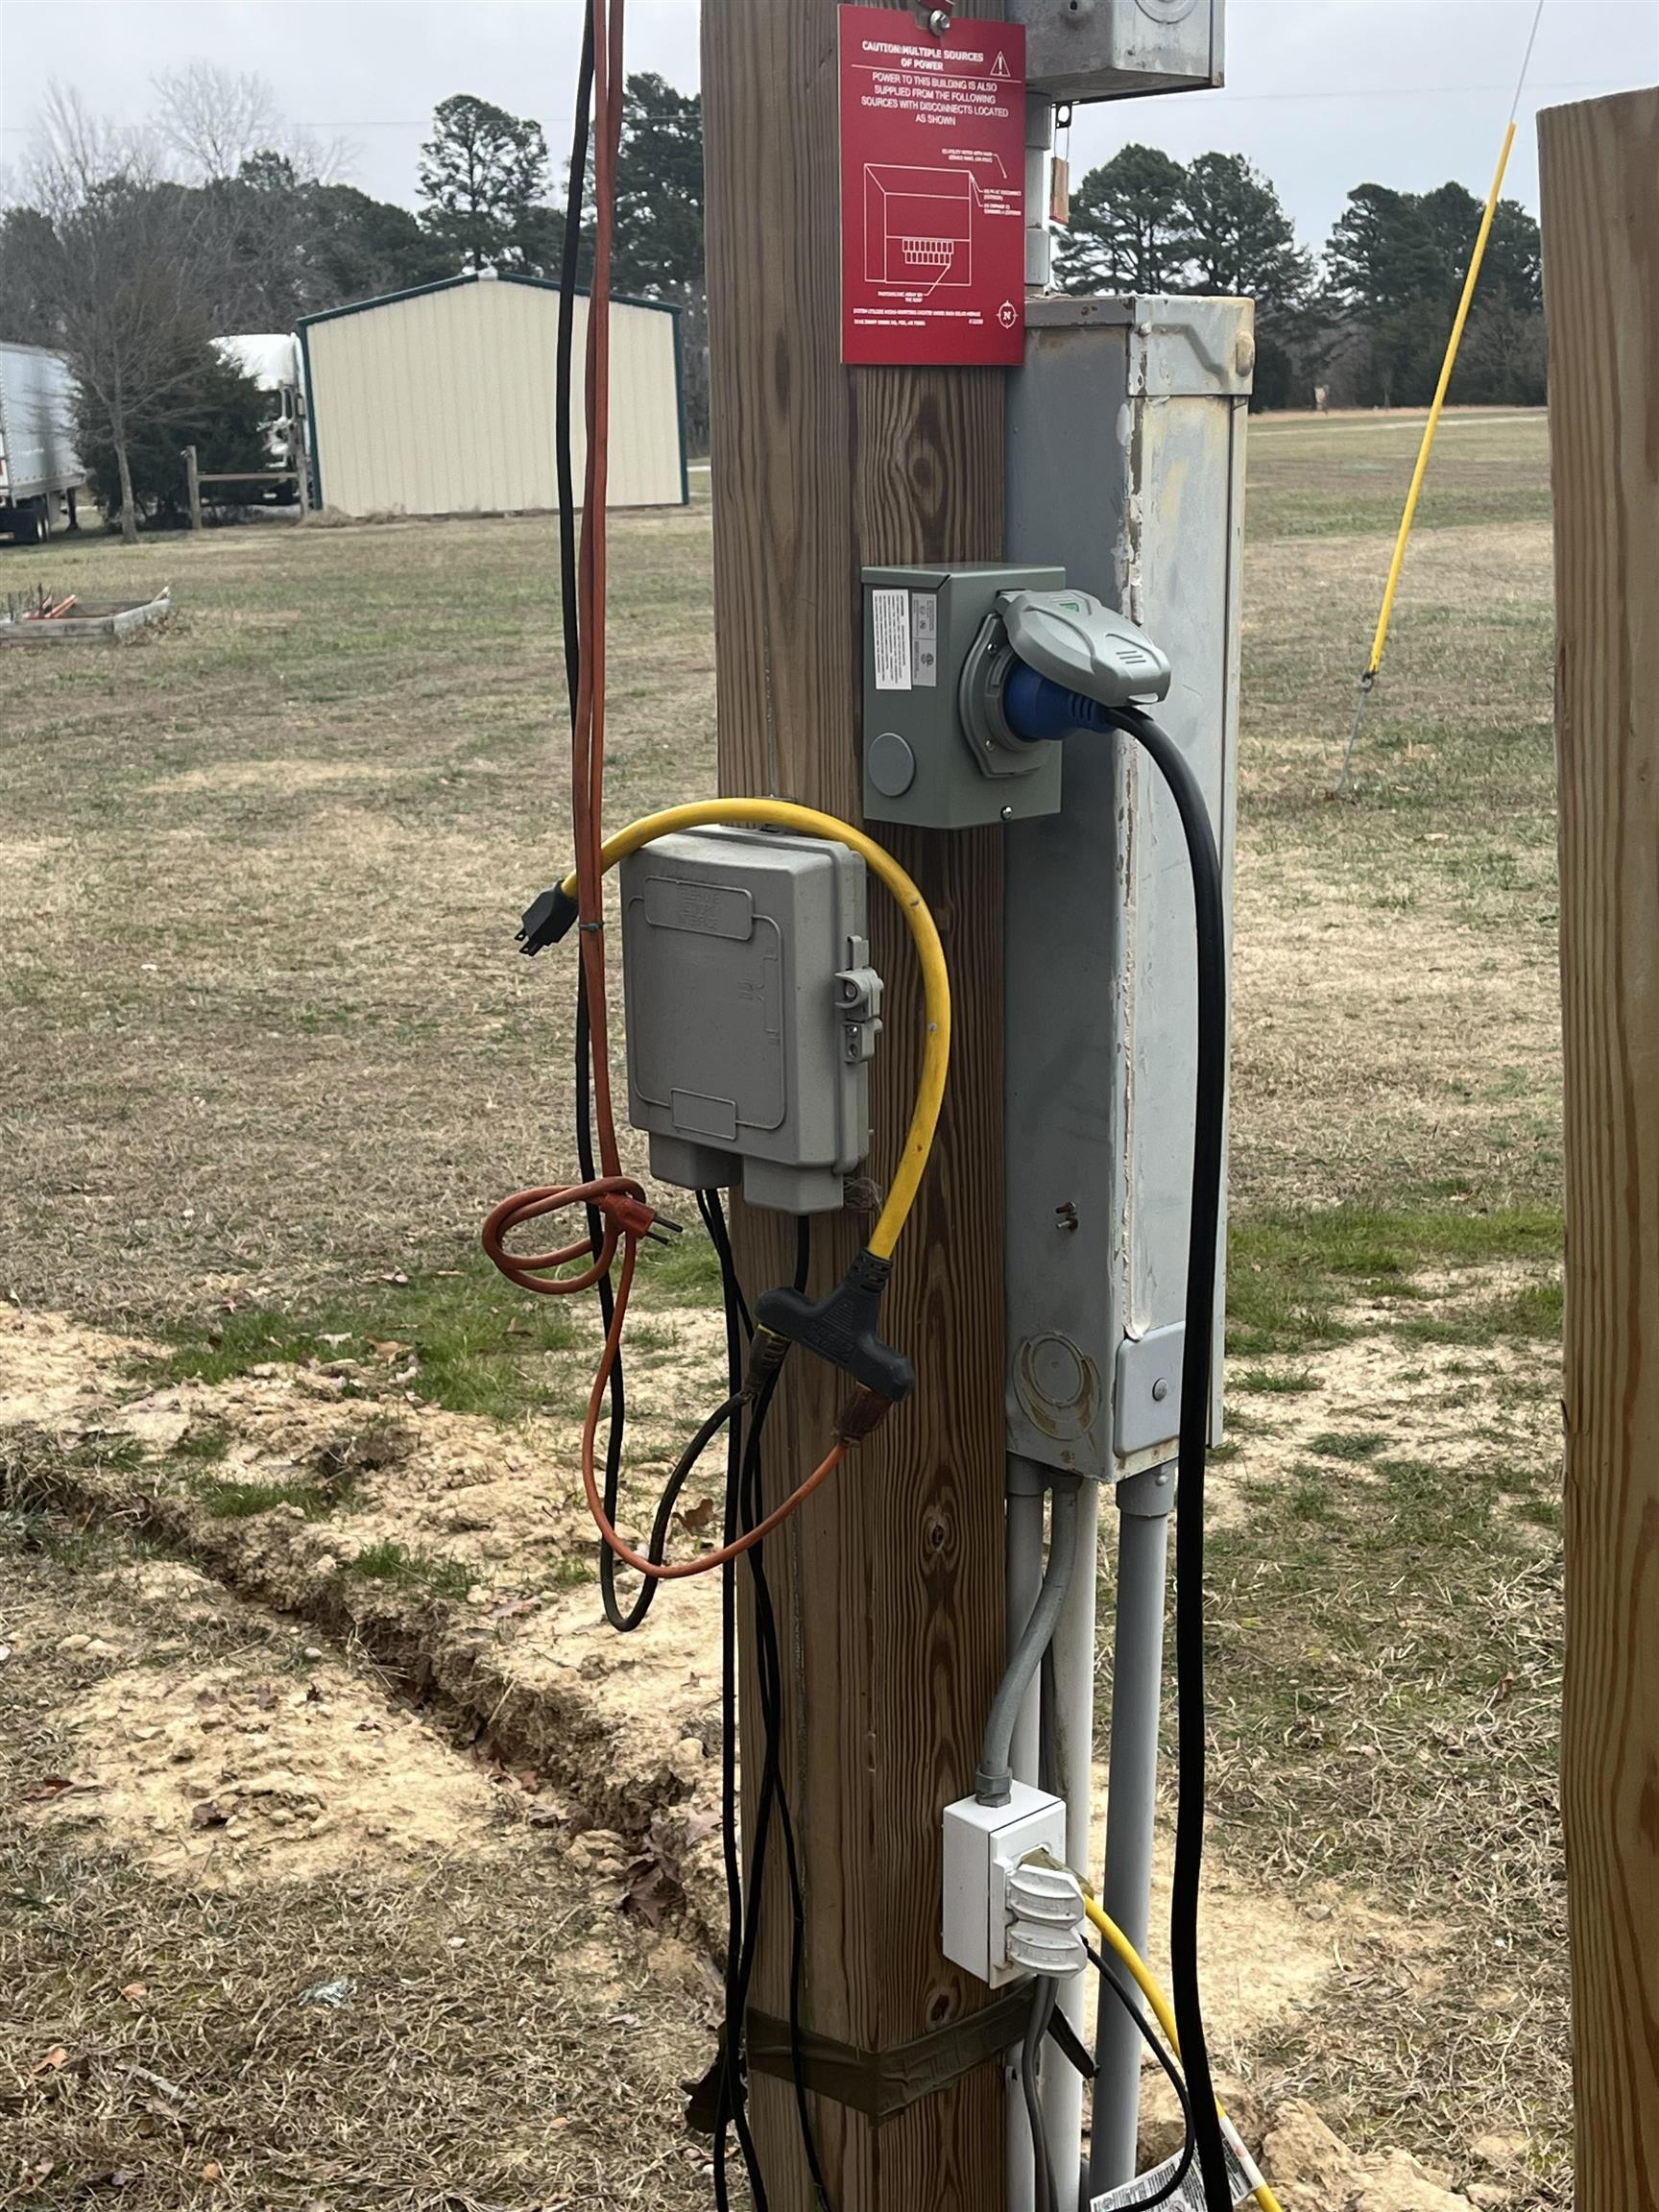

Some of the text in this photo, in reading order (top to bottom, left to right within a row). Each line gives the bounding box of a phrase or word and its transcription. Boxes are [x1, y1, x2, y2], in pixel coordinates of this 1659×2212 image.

[943, 50, 984, 62] SOURCES
[901, 58, 944, 70] OF POWER
[872, 72, 998, 92] POWER TO THIS BUILDING IS ALSO
[874, 84, 997, 105] SUPPLIED FROM THE FOLLOWING
[861, 96, 1009, 117] SOURCES WITH DISCONNECTS LOCATED
[915, 113, 956, 126] AS SHOWN
[1002, 310, 1012, 321] N
